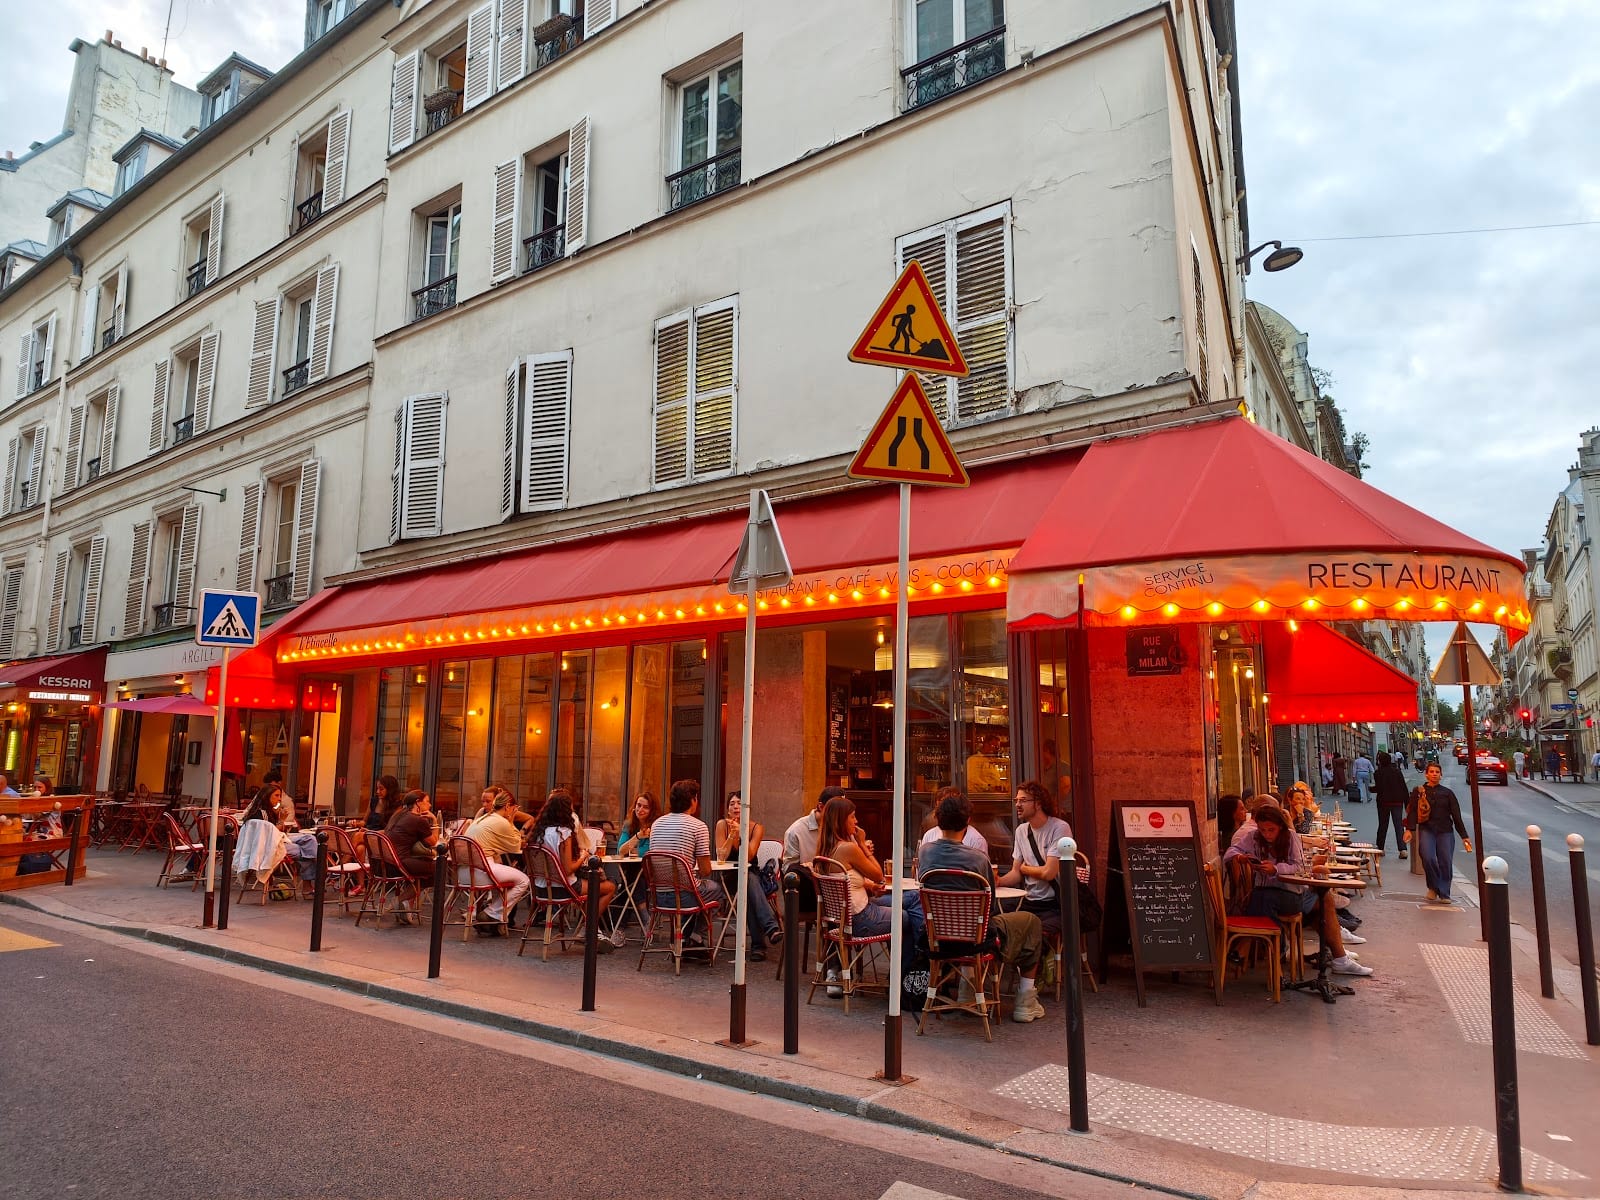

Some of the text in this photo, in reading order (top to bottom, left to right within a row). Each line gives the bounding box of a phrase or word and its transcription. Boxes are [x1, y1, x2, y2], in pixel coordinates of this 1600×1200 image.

[835, 569, 871, 590] CAFÉ
[1144, 562, 1206, 586] SERVICE
[1308, 562, 1501, 594] RESTAURANT
[1143, 573, 1214, 598] CONTINU
[1143, 635, 1161, 647] RUE
[1138, 656, 1168, 668] MILAN
[38, 676, 92, 689] KESSARI
